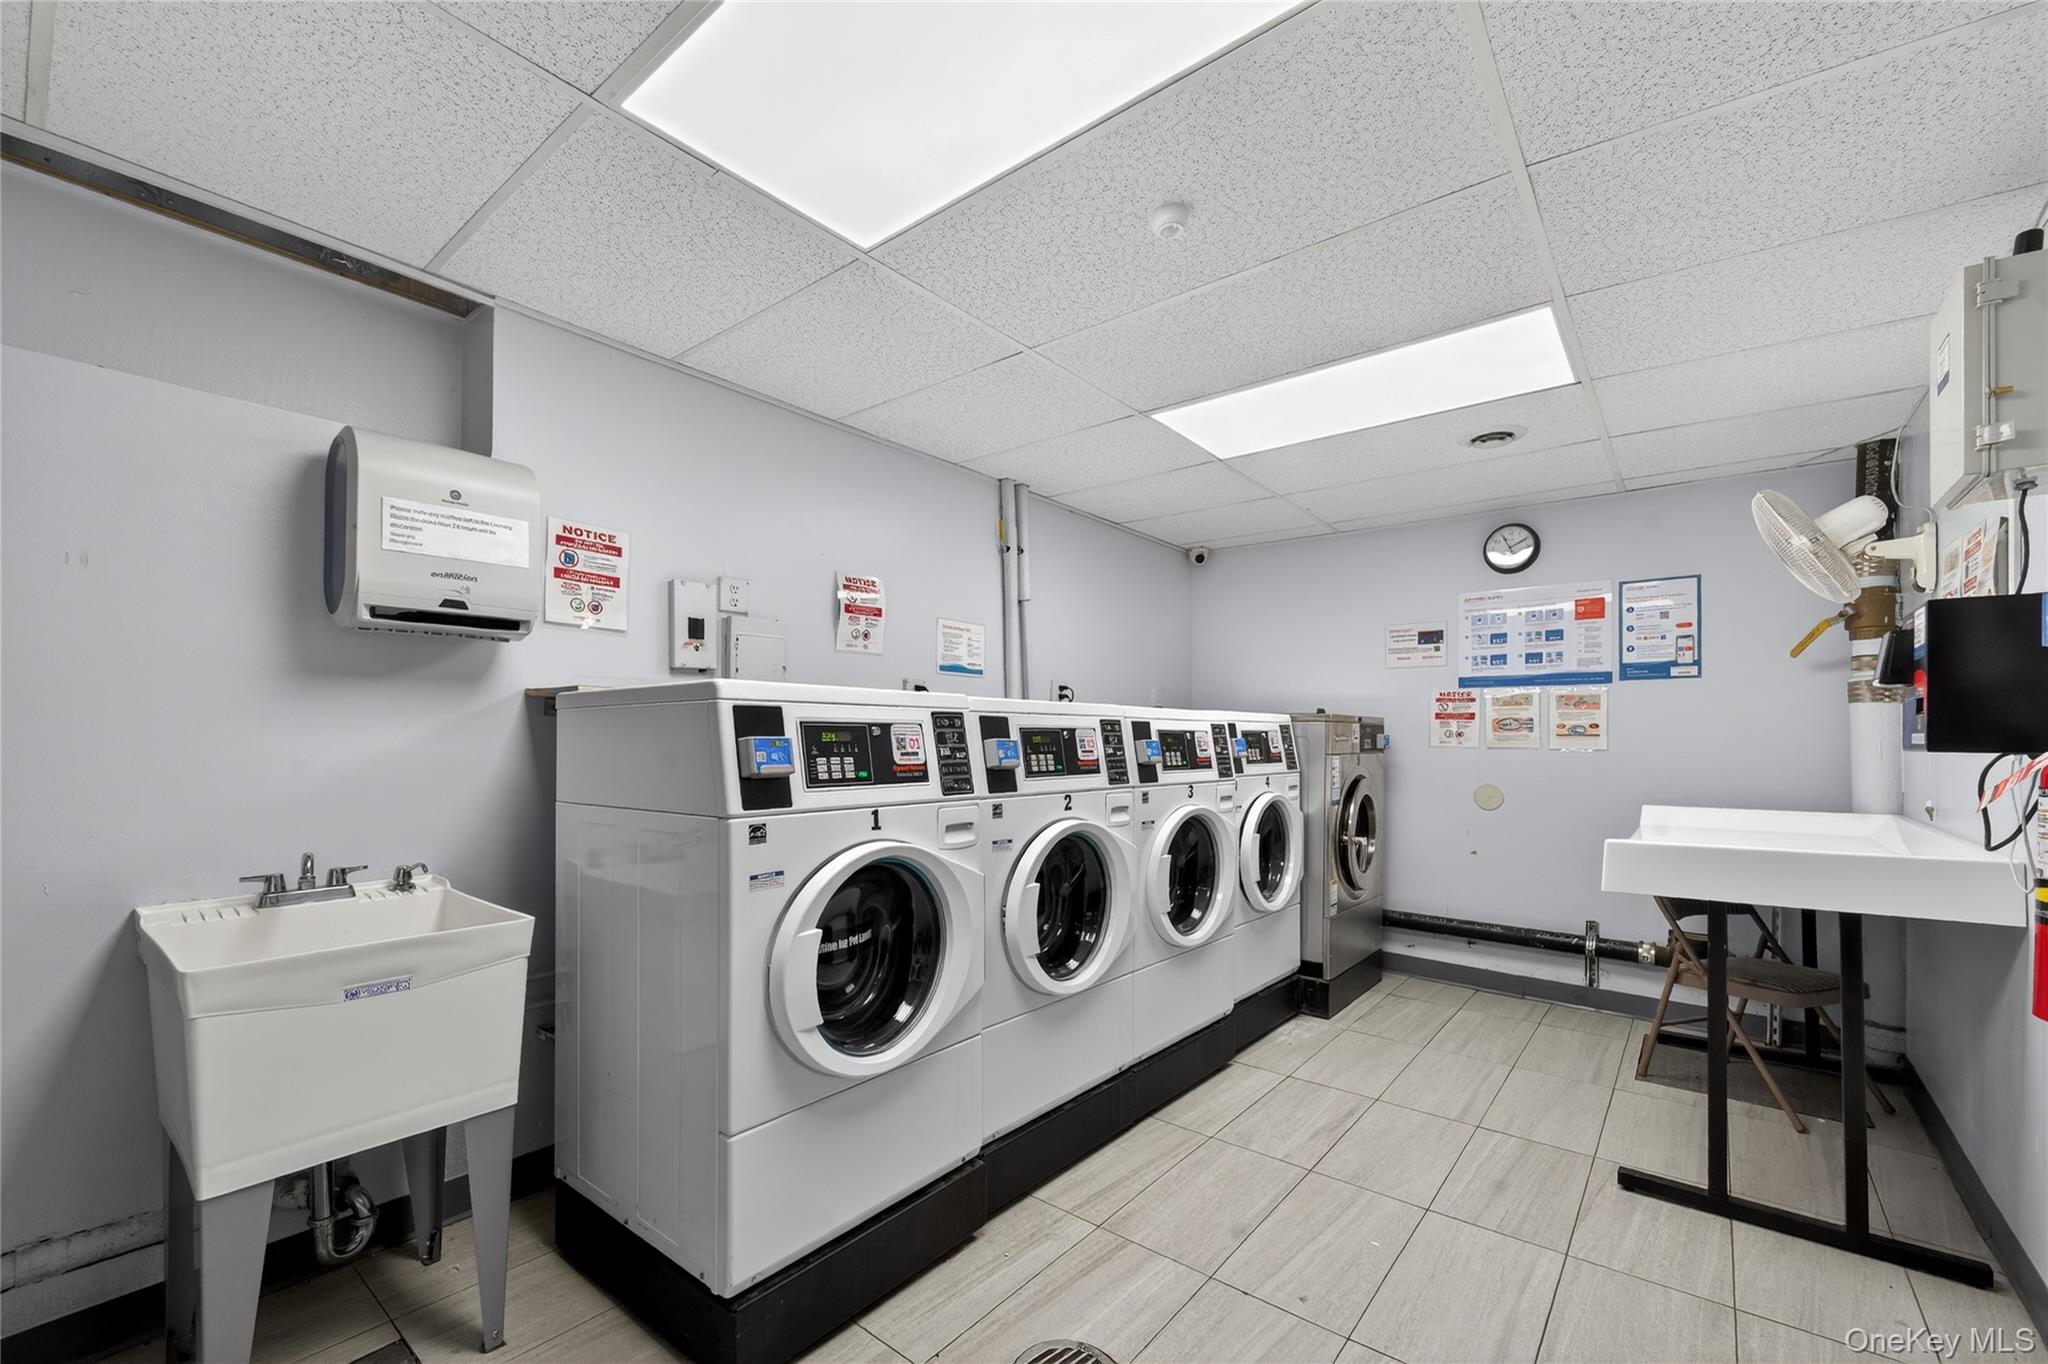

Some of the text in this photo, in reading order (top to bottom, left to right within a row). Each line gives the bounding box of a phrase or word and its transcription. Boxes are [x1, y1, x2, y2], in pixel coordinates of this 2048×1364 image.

[562, 525, 617, 544] NOTICE
[1265, 776, 1270, 788] 4
[1187, 785, 1194, 798] 3
[1064, 794, 1072, 811] 2
[871, 809, 882, 830] 1
